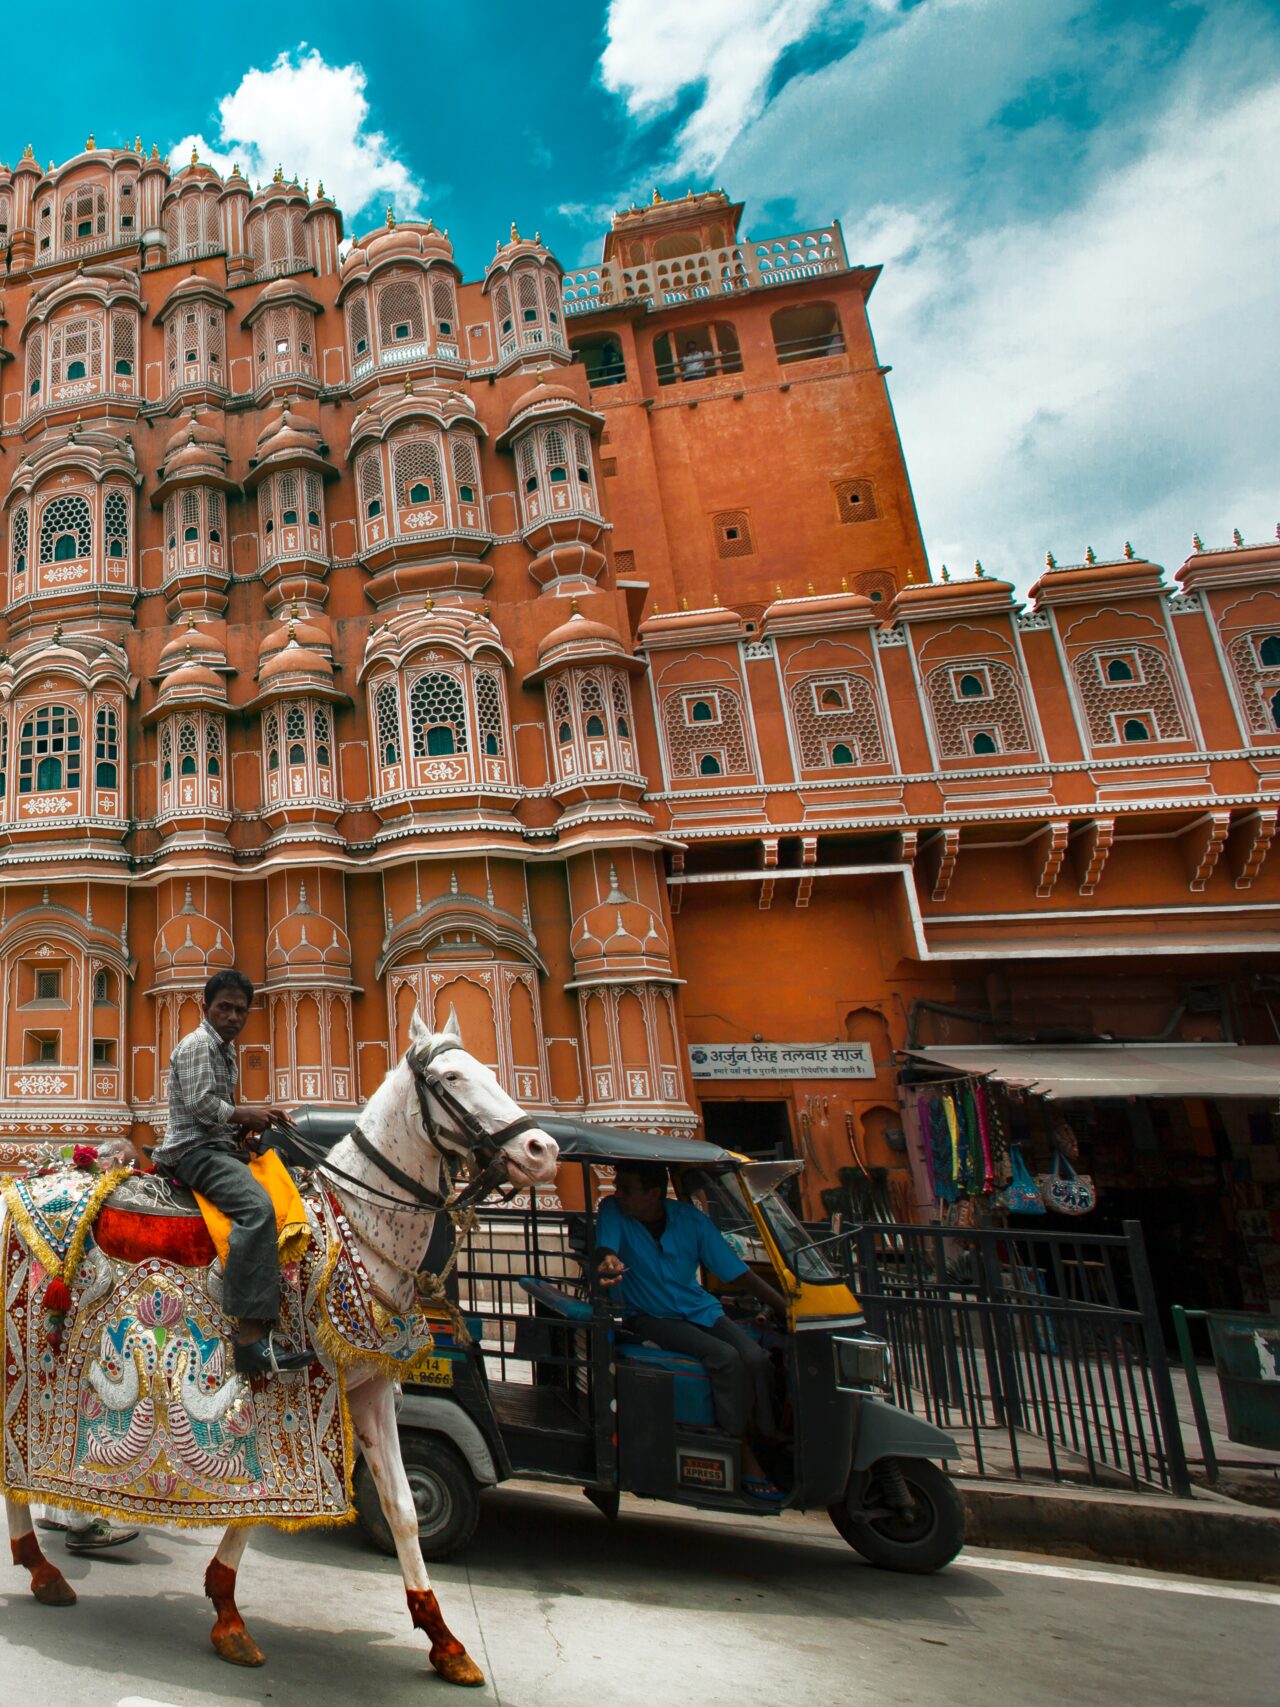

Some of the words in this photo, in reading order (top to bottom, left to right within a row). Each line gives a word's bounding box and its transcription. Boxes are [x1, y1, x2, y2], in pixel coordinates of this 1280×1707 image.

[710, 1046, 750, 1066] अर्जुन
[751, 1046, 778, 1063] सिंह
[781, 1049, 828, 1062] तलवार
[831, 1049, 867, 1062] साज
[426, 1359, 440, 1370] 14
[686, 1467, 721, 1480] XPRESS
